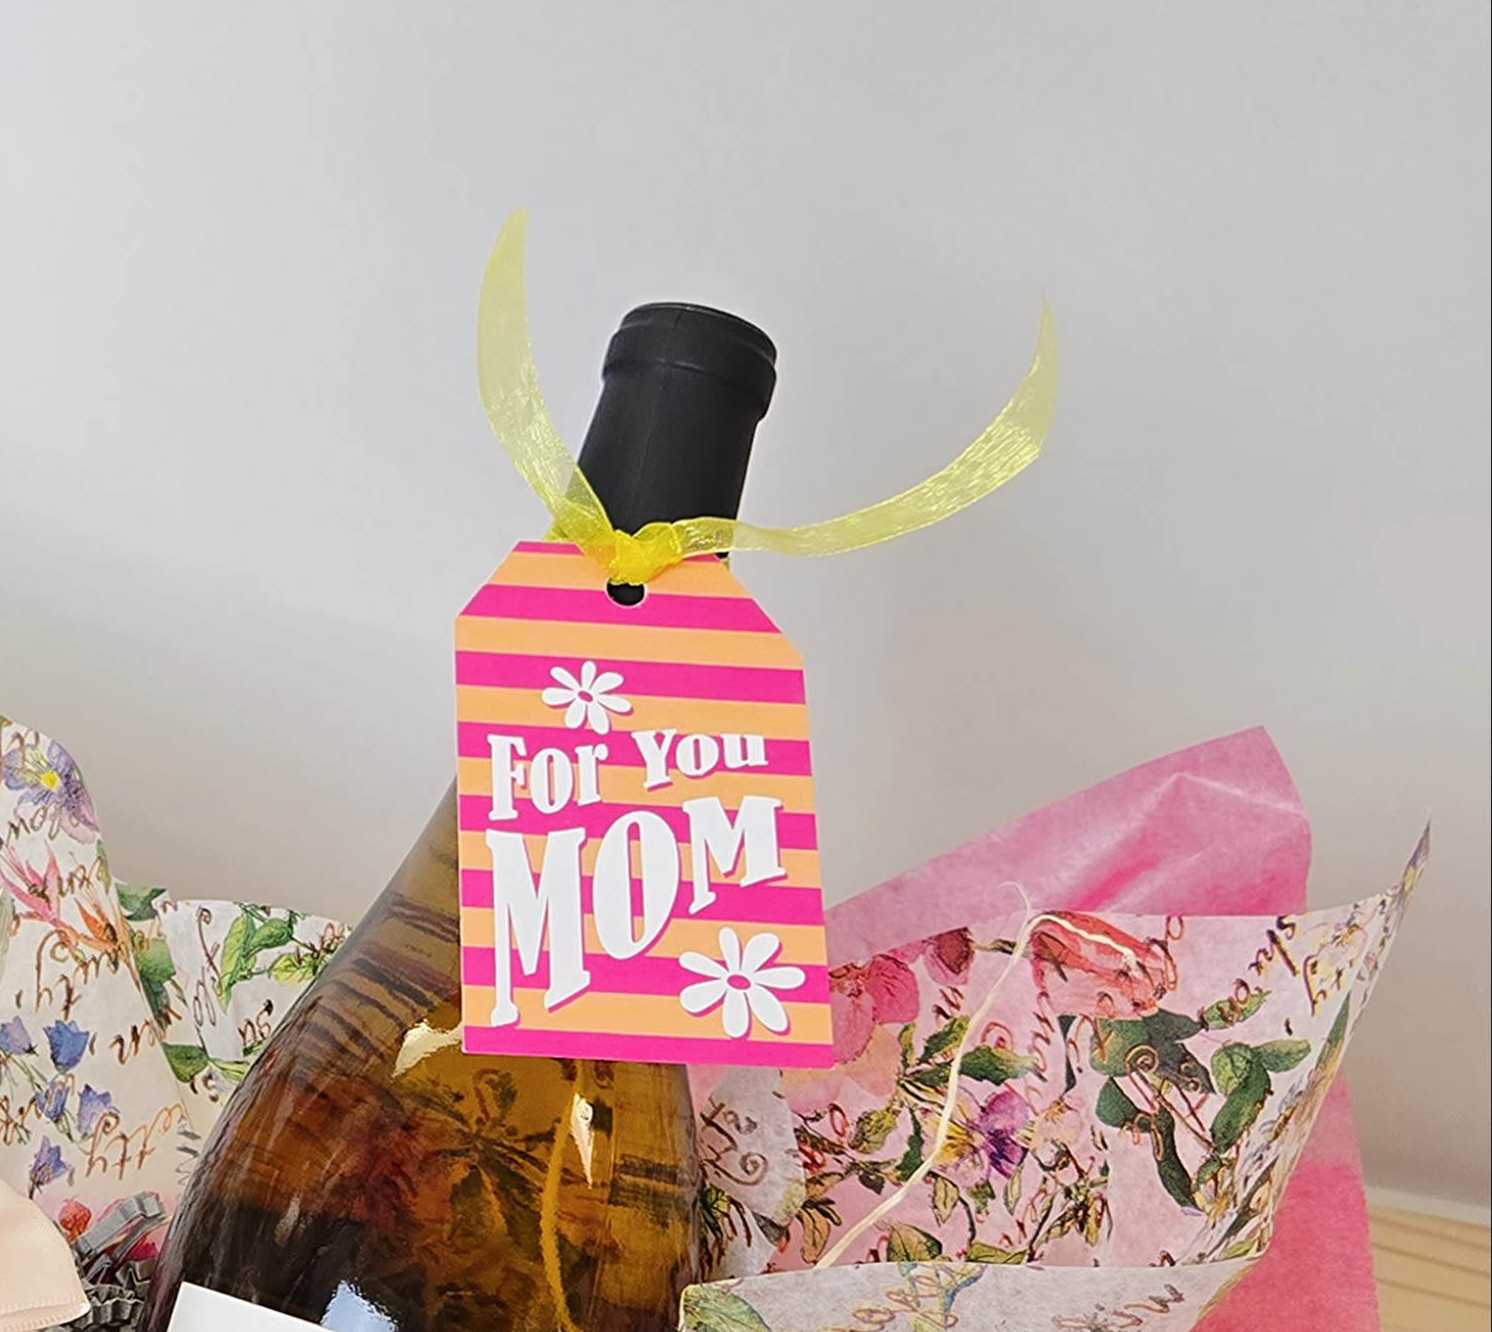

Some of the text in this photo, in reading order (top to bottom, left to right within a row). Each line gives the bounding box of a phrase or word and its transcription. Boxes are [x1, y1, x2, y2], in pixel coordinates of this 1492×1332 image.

[487, 729, 768, 821] For You
[485, 795, 787, 1027] MOM
